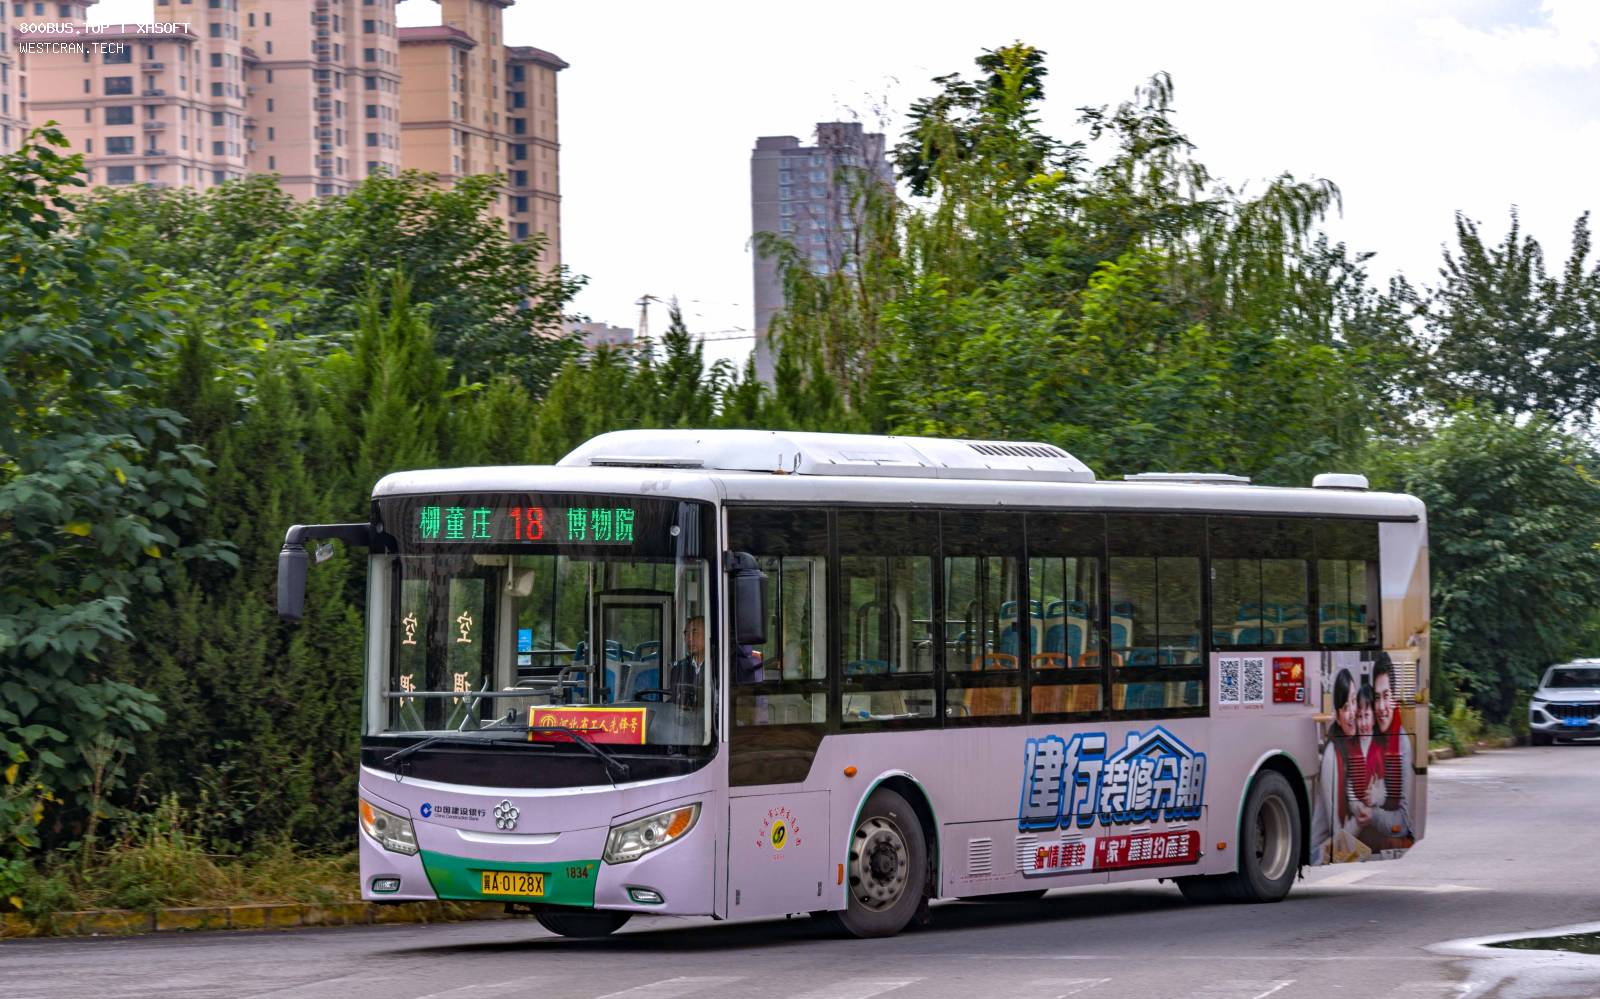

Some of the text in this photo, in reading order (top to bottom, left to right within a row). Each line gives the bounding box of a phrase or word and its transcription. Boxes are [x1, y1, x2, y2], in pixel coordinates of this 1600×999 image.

[420, 506, 635, 541] 柳董庄 18 博物院
[558, 715, 638, 734] 河北省工人先锋号
[1020, 727, 1205, 829] 建行装修分期
[434, 805, 486, 817] 中国建设银行
[565, 866, 588, 879] 1834
